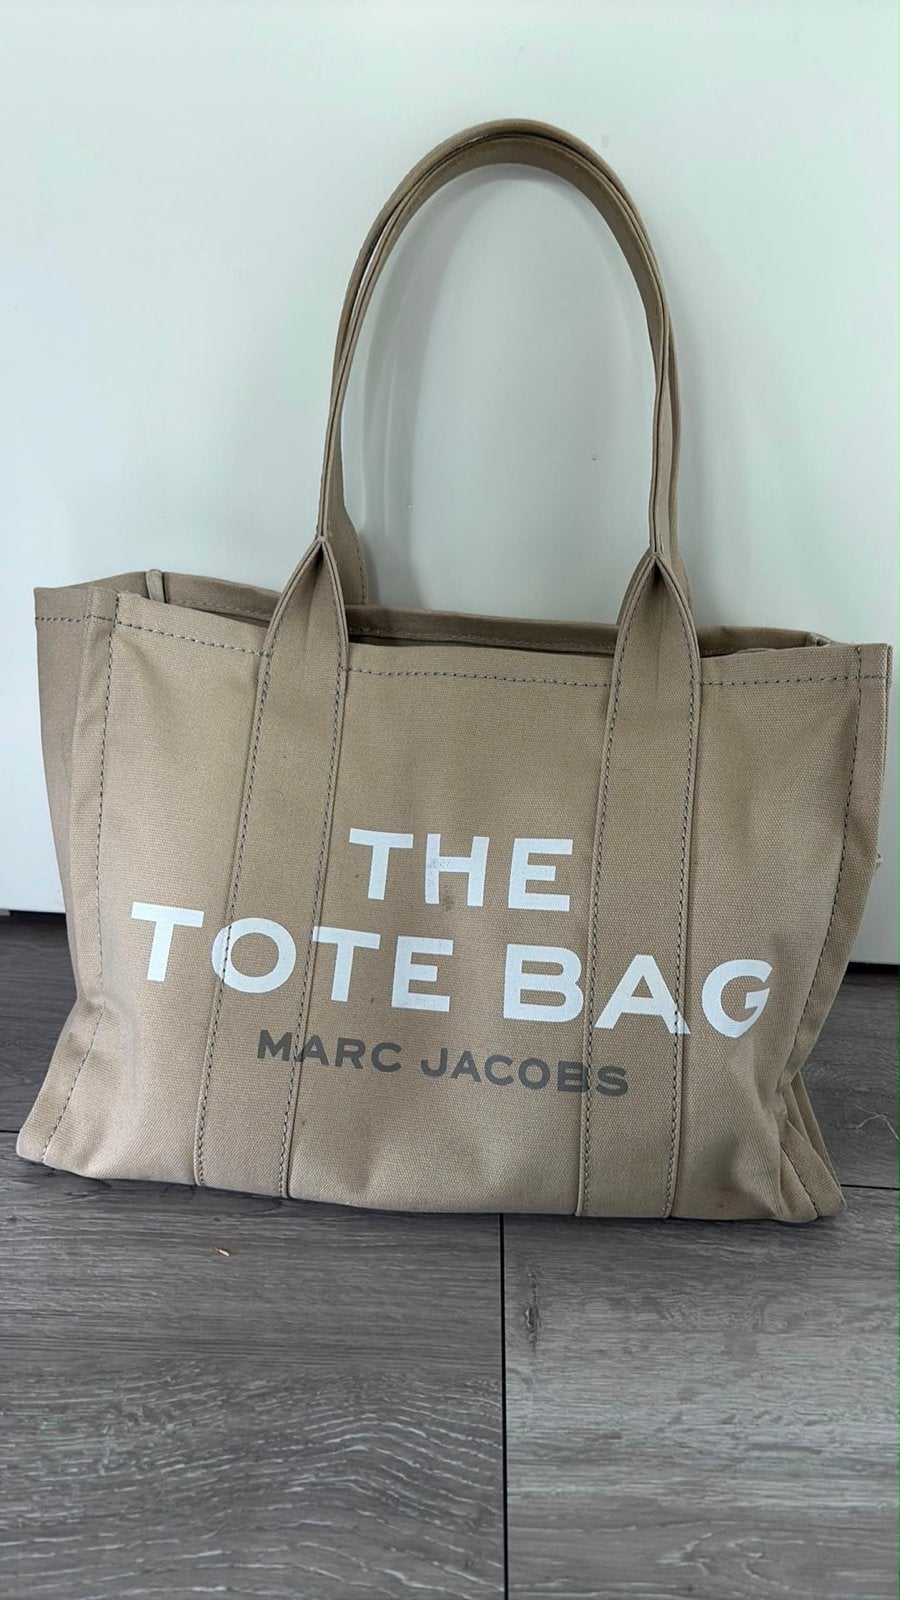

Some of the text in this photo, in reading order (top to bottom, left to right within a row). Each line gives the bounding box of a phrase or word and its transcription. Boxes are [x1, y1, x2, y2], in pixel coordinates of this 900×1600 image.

[348, 828, 574, 912] THE
[131, 902, 773, 1039] TOTE BAG
[257, 1029, 629, 1097] MARC JACOBS
